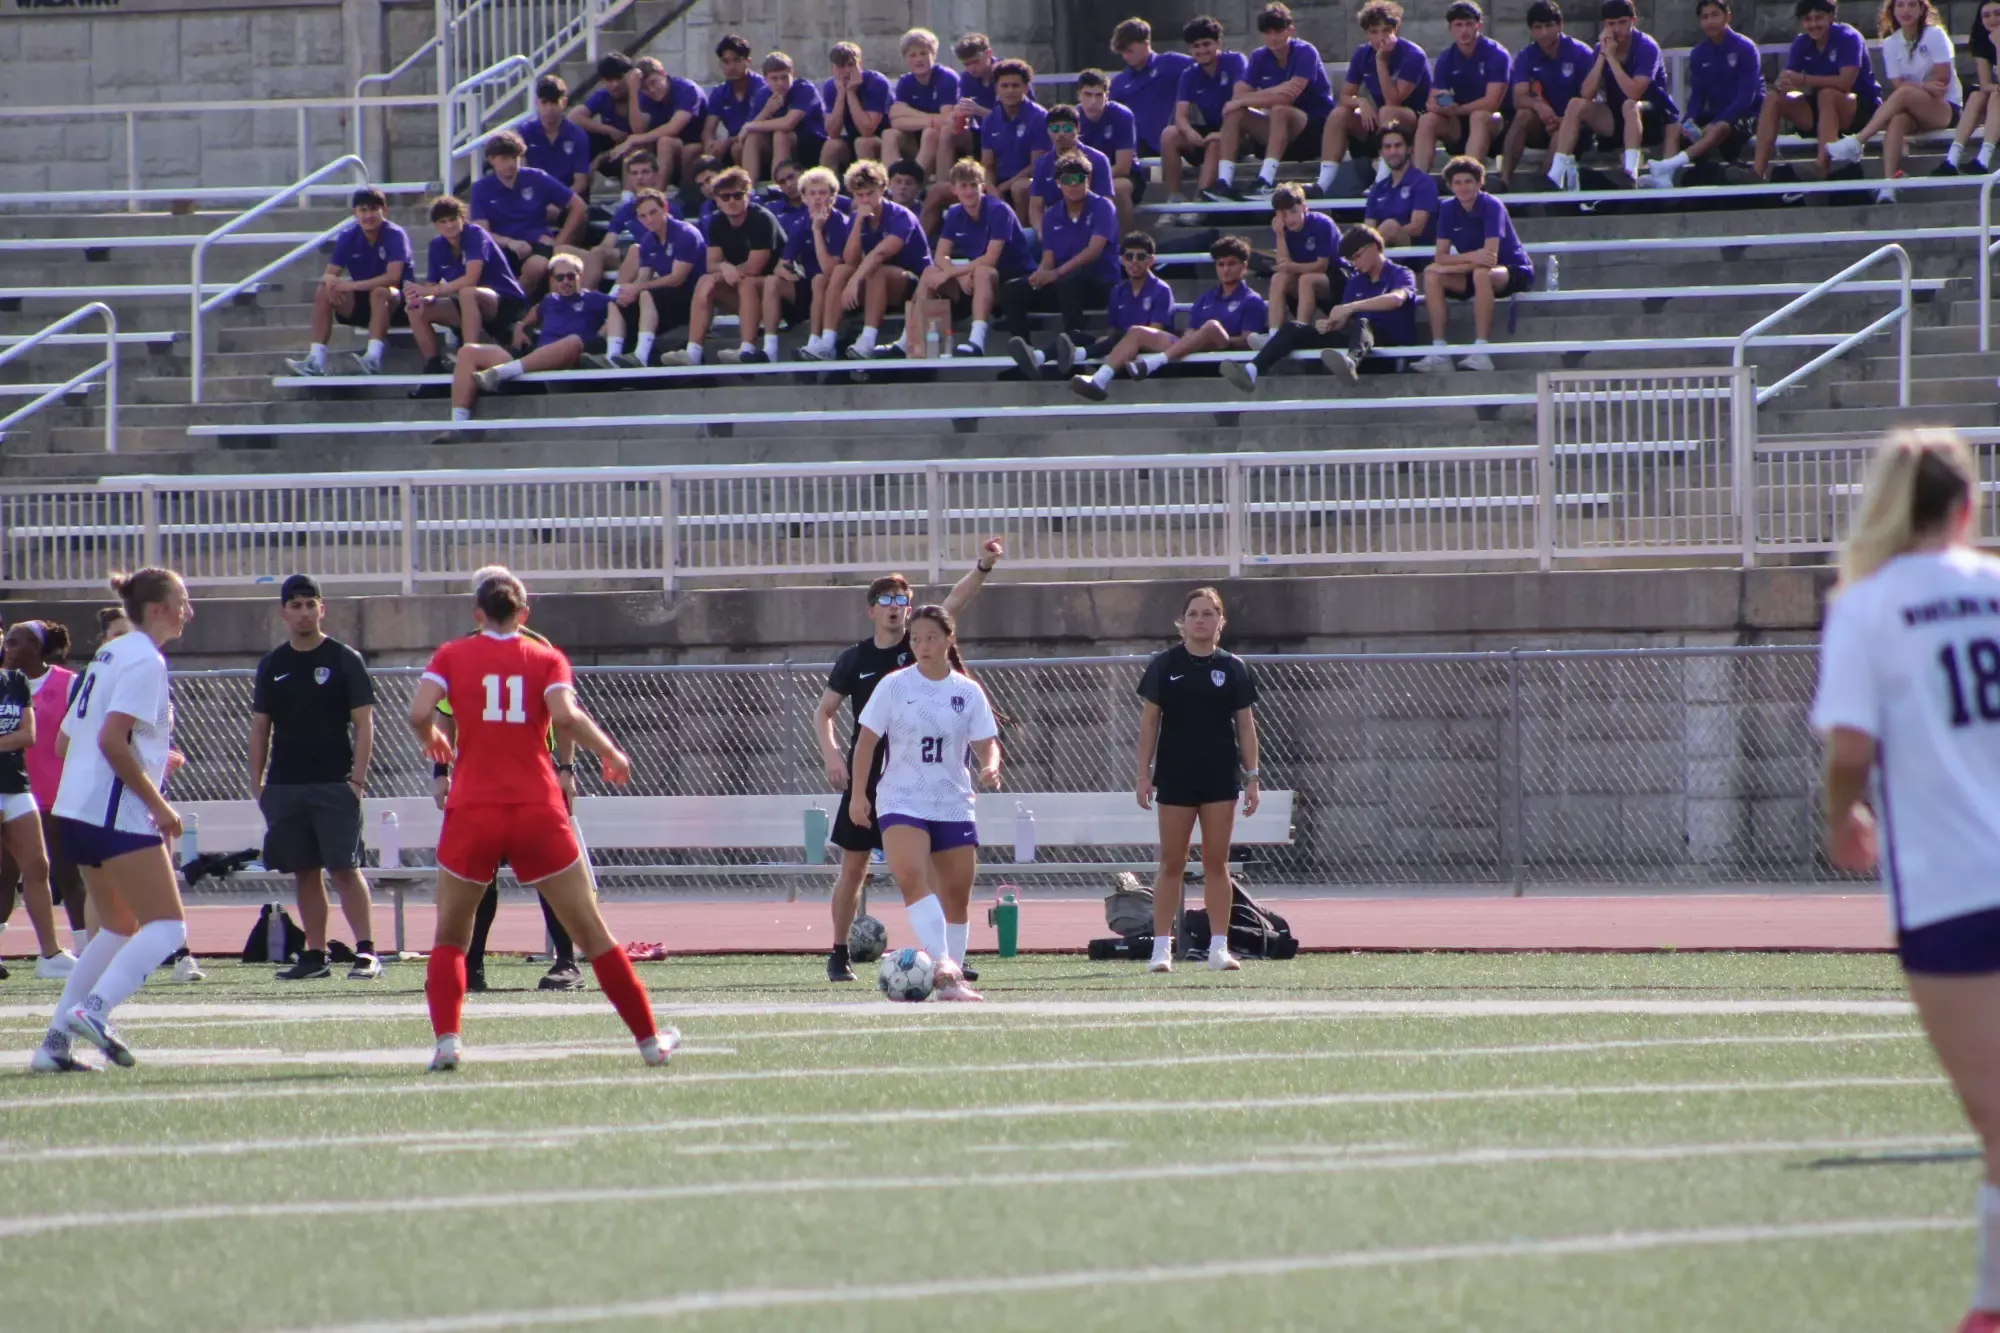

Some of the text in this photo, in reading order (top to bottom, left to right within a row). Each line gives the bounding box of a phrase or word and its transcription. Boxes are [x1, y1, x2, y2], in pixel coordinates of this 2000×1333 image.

[482, 673, 526, 724] 11
[1938, 637, 2000, 728] 18
[921, 736, 944, 764] 21
